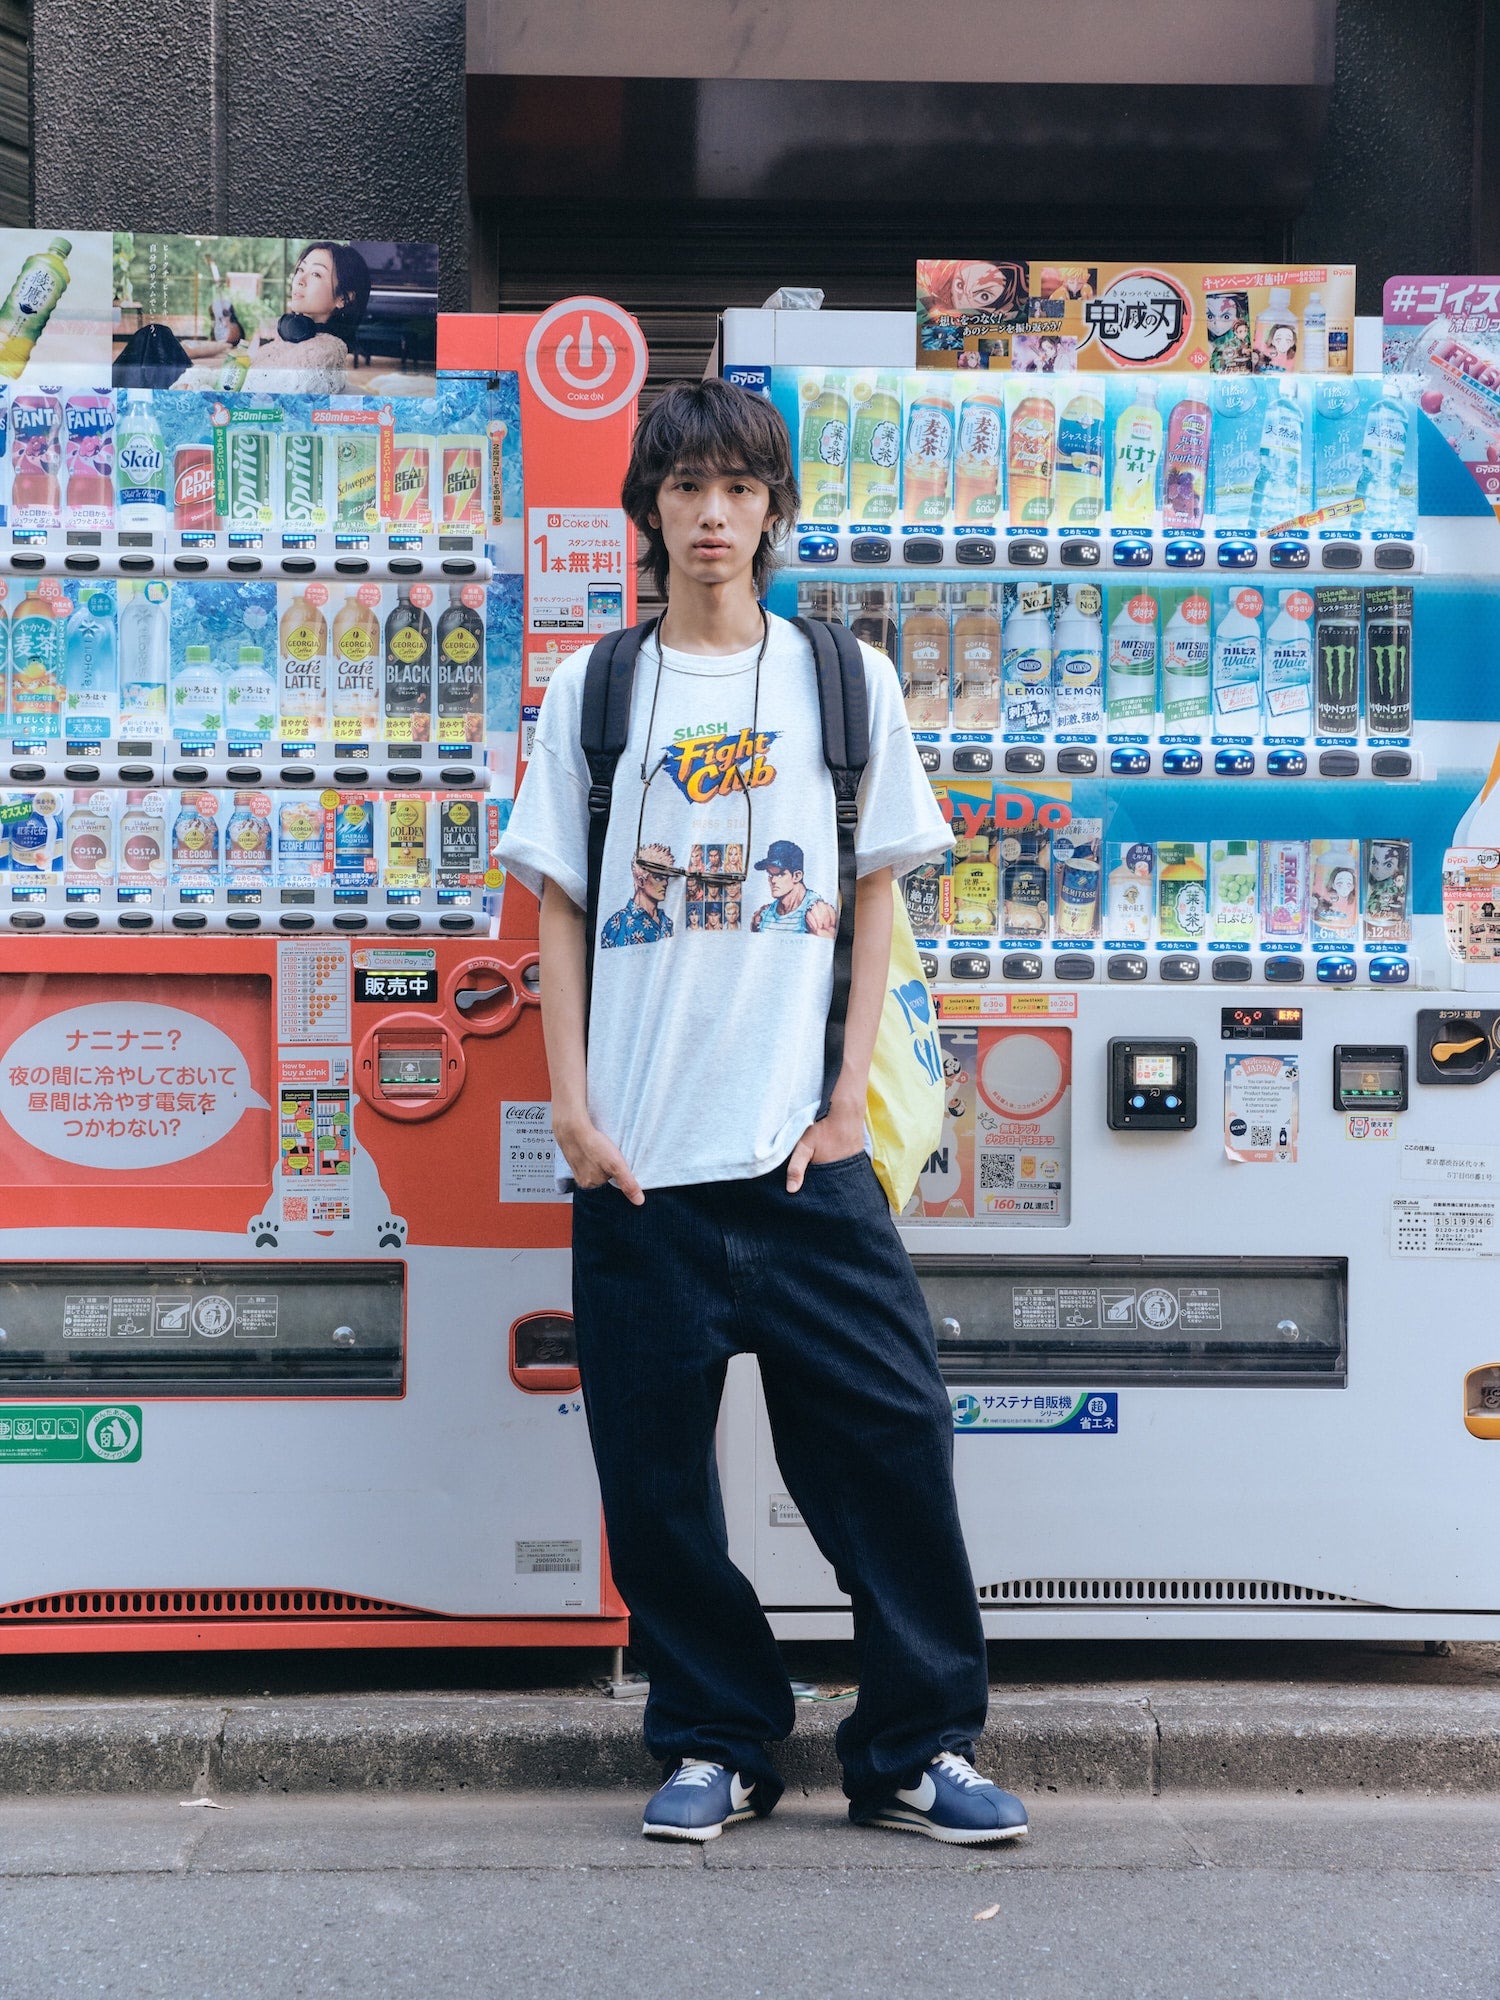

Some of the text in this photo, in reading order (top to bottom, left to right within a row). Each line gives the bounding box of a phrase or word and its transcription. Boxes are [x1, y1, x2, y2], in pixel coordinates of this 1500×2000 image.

[1203, 273, 1288, 289] キャンペーン実施中!
[1391, 283, 1499, 313] #ゴイス
[939, 313, 1004, 327] 想いをつなぐ!
[1076, 298, 1183, 350] 鬼滅の刃
[962, 321, 1062, 337] あのシーンを振り返ろう!
[730, 372, 764, 386] DyDo
[1221, 385, 1248, 398] 自然の
[1323, 385, 1350, 398] 自然の
[1442, 374, 1483, 404] SPARKLING
[567, 392, 604, 401] Coke ON
[1225, 398, 1244, 409] 恵み
[1327, 398, 1346, 409] 恵み
[13, 408, 58, 429] FANTA
[67, 408, 114, 429] FANTA
[315, 412, 374, 421] 250ml缶コーナー
[920, 418, 941, 456] 麦茶
[970, 417, 992, 455] 麦茶
[1061, 431, 1103, 445] ジャスミン茶
[1265, 425, 1300, 441] 天然水
[1367, 426, 1404, 442] 天然水
[827, 424, 844, 462] 葉の茶
[879, 425, 895, 463] 葉の茶
[1118, 446, 1156, 463] バナナ
[1236, 428, 1248, 477] 富士山の
[1337, 430, 1350, 479] 富士山の
[395, 467, 425, 483] REAL
[447, 467, 477, 483] REAL
[1476, 464, 1500, 474] DyDo
[233, 434, 263, 521] Sprite
[286, 434, 316, 521] Sprite
[338, 472, 376, 496] Schweppes
[395, 478, 425, 493] GOLD
[447, 478, 477, 494] GOLD
[1327, 503, 1360, 517] コーナー
[562, 518, 608, 528] Coke ON
[568, 539, 620, 547] スタンプたまると
[533, 534, 621, 573] 1本無料!
[39, 587, 59, 596] 650
[1317, 589, 1348, 600] Unleash
[1338, 592, 1360, 602] Beast!
[1388, 591, 1411, 601] Beast!
[1022, 588, 1051, 611] No.1
[1080, 601, 1098, 610] No.1
[1238, 602, 1262, 611] すっきり!
[1288, 605, 1313, 613] すっきり!
[1318, 604, 1361, 613] モンスターエナジー
[1368, 604, 1411, 613] モンスターエナジー
[1133, 609, 1154, 619] 爽快
[1186, 610, 1208, 620] 爽快
[14, 633, 58, 658] 麦茶
[393, 641, 424, 649] GEORGIA
[444, 642, 476, 650] GEORGIA
[1223, 647, 1256, 655] カルピス
[1273, 650, 1307, 658] カルピス
[285, 660, 321, 675] Café
[338, 660, 373, 675] Café
[1221, 655, 1257, 667] Water
[1272, 658, 1308, 669] Water
[386, 665, 431, 684] BLACK
[439, 666, 483, 684] BLACK
[285, 676, 321, 690] LATTE
[338, 676, 374, 690] LATTE
[1007, 687, 1050, 696] LEMON
[1056, 687, 1100, 696] LEMON
[1008, 702, 1036, 719] 刺激、
[15, 715, 56, 724] 香ばしくて、
[280, 719, 309, 727] 軽やかな
[334, 719, 362, 727] 軽やかな
[386, 720, 420, 729] 飲みやすく
[439, 720, 473, 729] 飲みやすく
[1057, 711, 1100, 727] 刺激、強め
[72, 724, 103, 733] 天然水
[281, 728, 309, 736] ミルク感
[335, 728, 362, 737] ミルク感
[386, 729, 412, 738] 深いコク
[439, 730, 466, 738] 深いコク
[673, 721, 728, 741] SLASH
[673, 727, 771, 782] Fight
[687, 756, 777, 804] Club
[0, 804, 32, 819] オススメ!
[17, 827, 46, 836] 紅茶花伝
[390, 826, 424, 837] GOLDEN
[325, 812, 334, 870] お手頃価格!
[443, 833, 477, 845] BLACK
[74, 847, 104, 855] COSTA
[127, 848, 157, 856] COSTA
[178, 850, 213, 859] ICE COCOA
[231, 851, 266, 860] ICE COCOA
[1284, 855, 1297, 905] FRISK
[910, 889, 935, 905] 絶品
[906, 901, 936, 913] BLACK
[1117, 903, 1144, 912] 午後の紅茶
[1185, 890, 1201, 928] 葉の茶
[1217, 913, 1254, 924] 白ぶどう
[365, 977, 428, 996] 販売中
[1279, 1010, 1300, 1020] 販売中
[1439, 1010, 1481, 1019] おつり・返却
[66, 1029, 182, 1051] ナニナニ?
[8, 1066, 237, 1086] 夜の間に冷やしておいて
[282, 1069, 297, 1077] buy
[1246, 1065, 1278, 1075] JAPAN!
[28, 1092, 216, 1112] 昼間は冷やす電気を
[505, 1106, 547, 1120] Coca-Cola
[63, 1119, 181, 1138] つかわない?
[1000, 1123, 1041, 1135] 無料アプリ
[1374, 1128, 1388, 1137] OK
[985, 1135, 1055, 1145] ダウンロードはコチラ
[1404, 1144, 1435, 1152] ここの住所は
[1426, 1158, 1486, 1168] 東京都渋谷区代々木
[982, 1395, 1073, 1409] サステナ自販機
[1091, 1400, 1104, 1413] 超
[94, 1408, 134, 1423] のんだあとは
[1079, 1417, 1115, 1430] 省エネ
[97, 1450, 130, 1459] リサイクル
